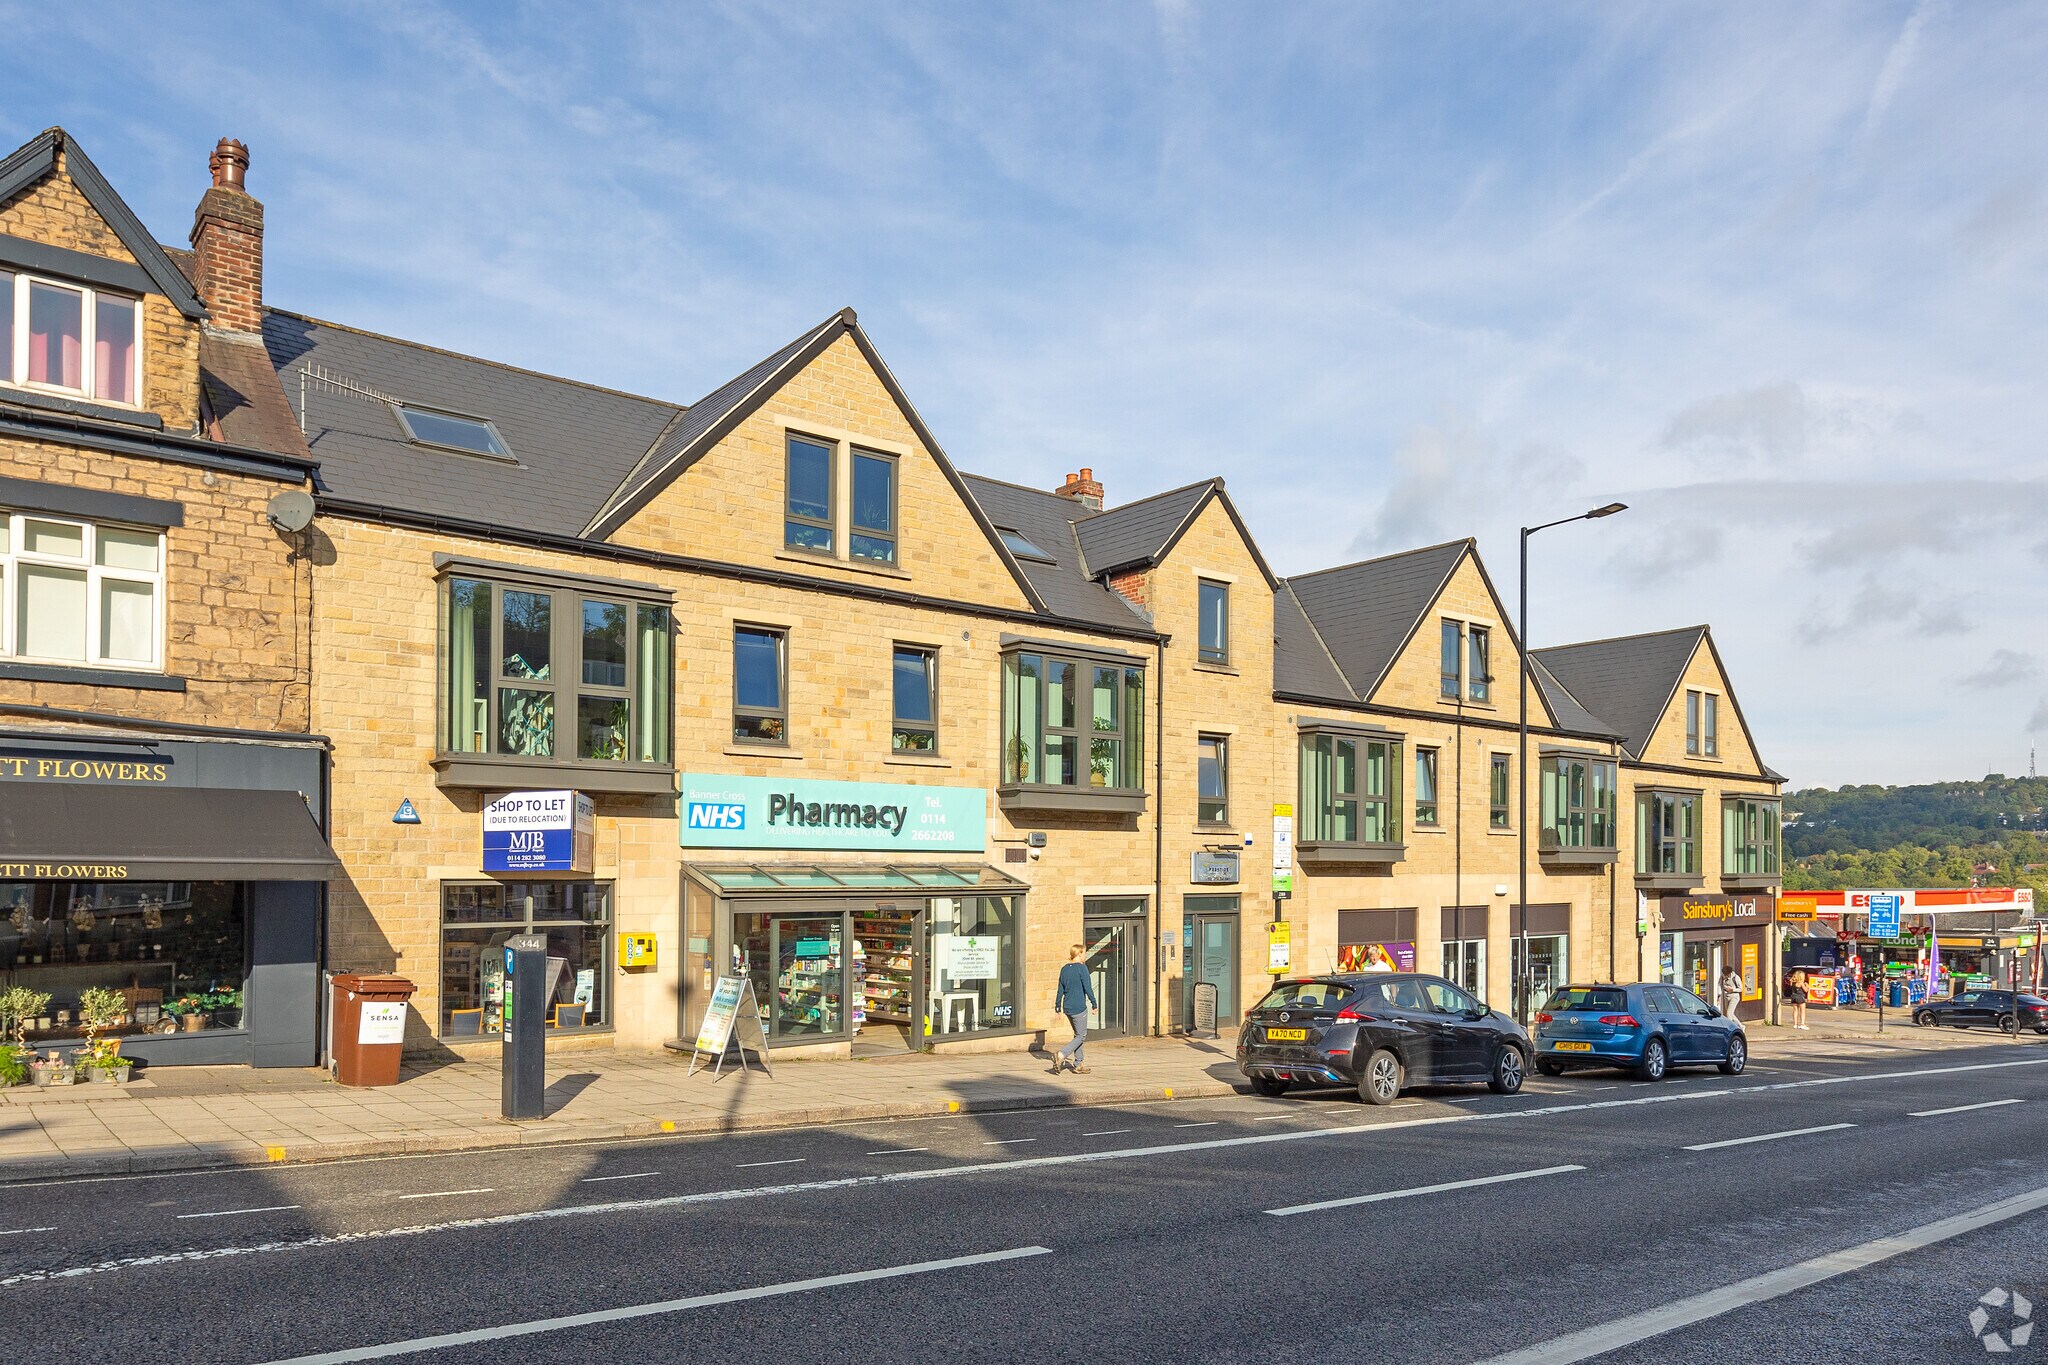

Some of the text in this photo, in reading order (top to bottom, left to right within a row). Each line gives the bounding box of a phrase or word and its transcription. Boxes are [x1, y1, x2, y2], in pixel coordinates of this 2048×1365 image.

[37, 759, 167, 781] FLOWERS
[689, 790, 746, 800] Banner Cross
[491, 799, 566, 813] SHOP TO LET
[925, 796, 942, 808] Tel.
[489, 815, 567, 824] (DUE TO RELOCATION)
[690, 804, 744, 828] NHS
[768, 793, 908, 837] Pharmacy
[921, 813, 945, 824] 0114
[767, 827, 888, 837] DELIVERING HEALTHCARE TO YOU
[911, 829, 955, 841] 2662208
[509, 831, 545, 852] MJB
[34, 864, 128, 878] FLOWERS
[2018, 892, 2031, 903] ESSO
[1683, 898, 1756, 921] Sainsbury's Local
[519, 940, 540, 949] 344
[507, 952, 513, 969] P
[994, 1006, 1012, 1016] NHS
[1271, 1030, 1288, 1038] YA70
